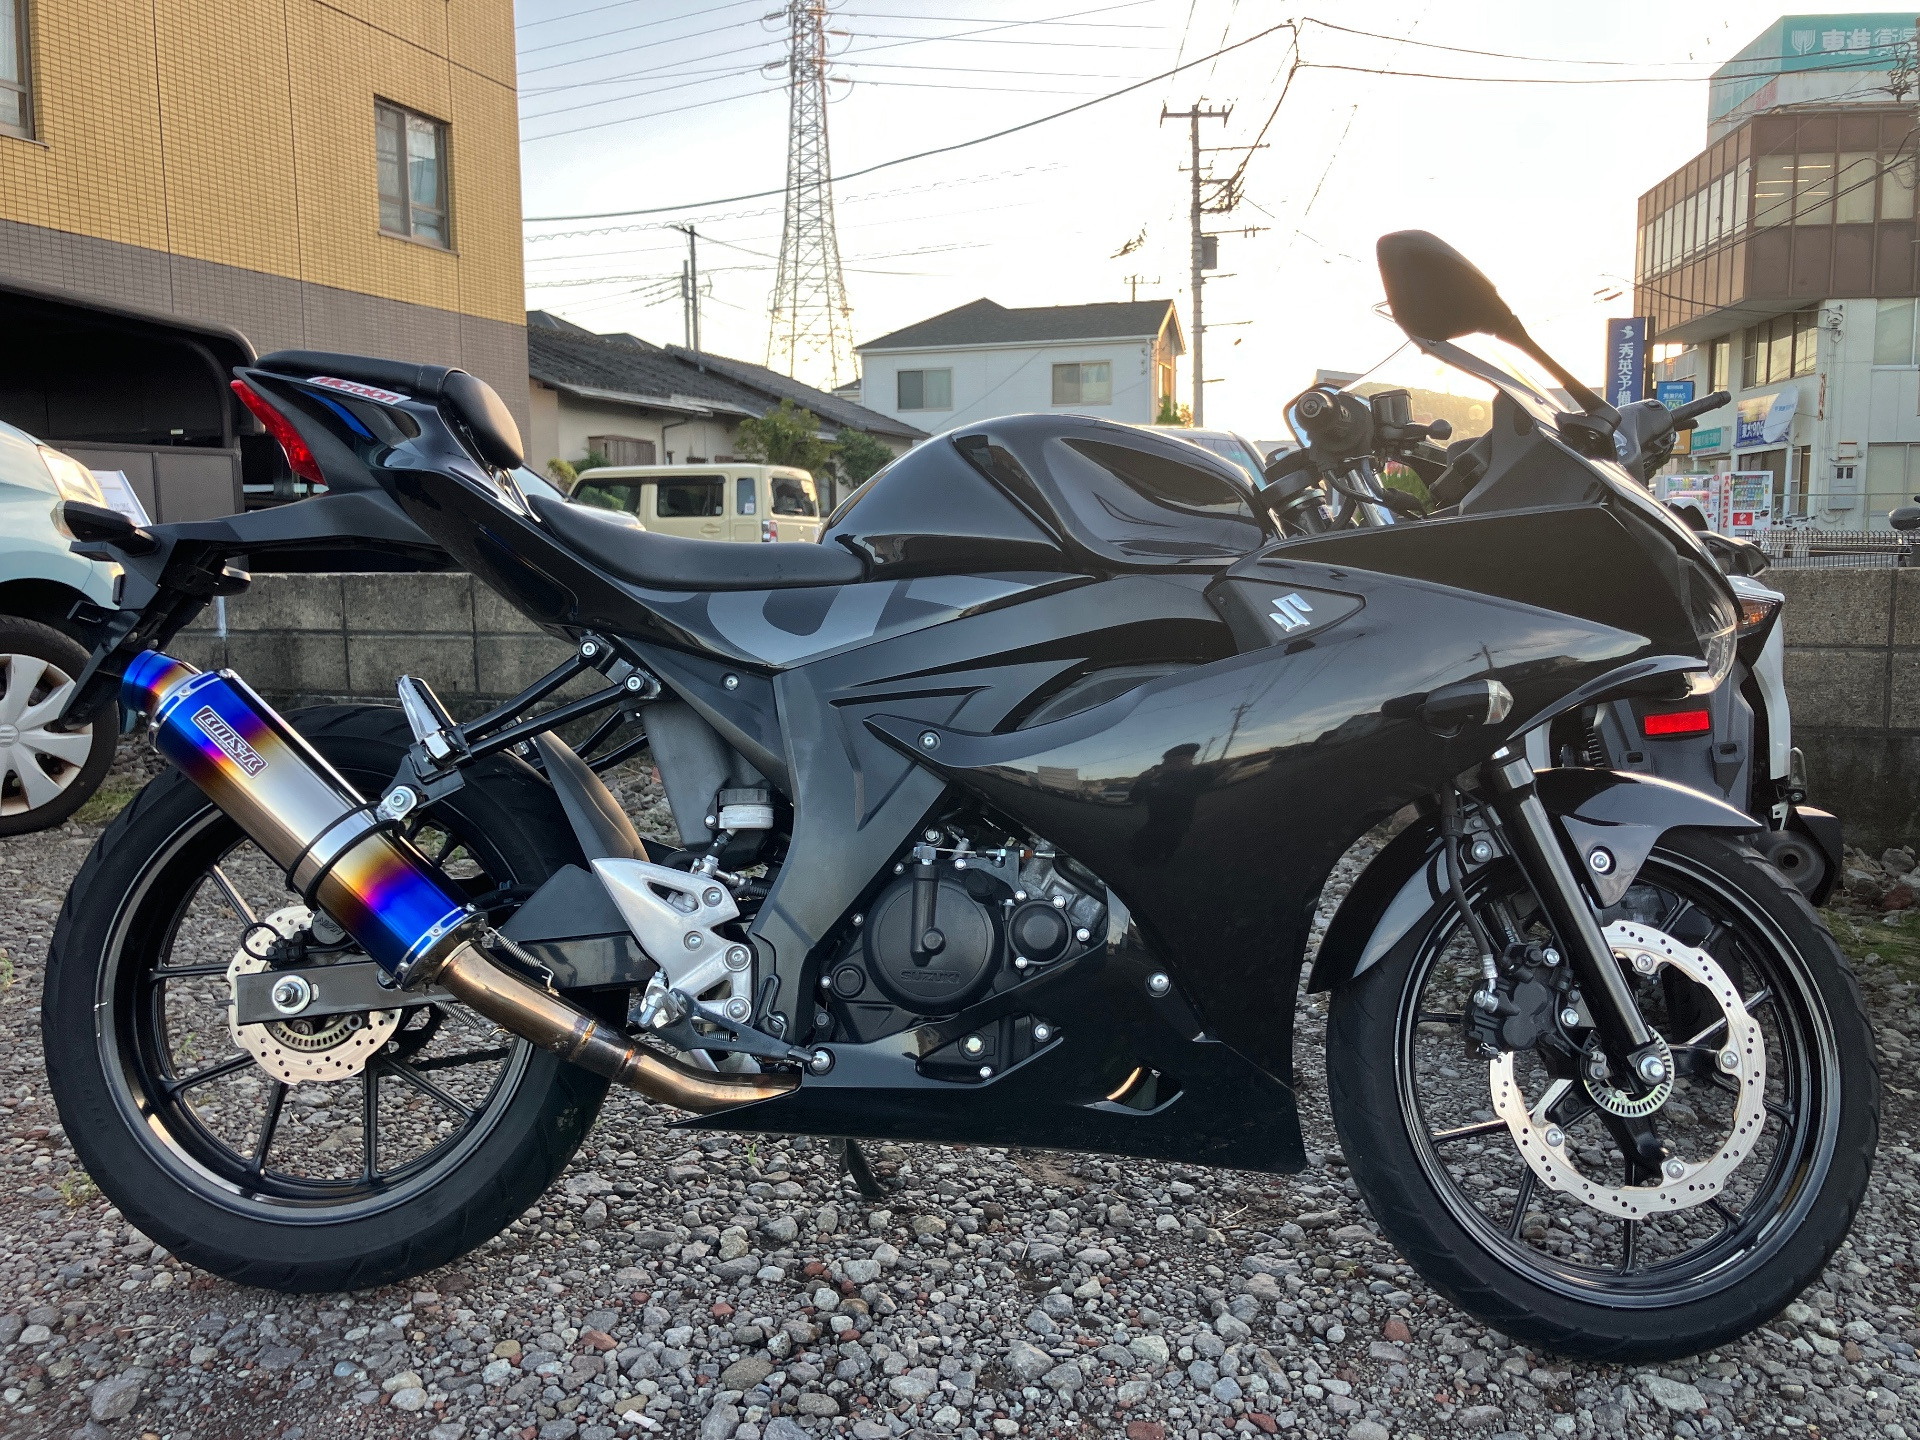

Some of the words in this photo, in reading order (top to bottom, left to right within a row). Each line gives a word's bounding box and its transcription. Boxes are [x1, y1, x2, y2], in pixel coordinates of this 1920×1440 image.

[313, 376, 400, 404] Microlon
[1617, 342, 1634, 406] 秀英予備
[201, 710, 264, 772] BMS-R
[899, 970, 961, 984] SUZUKI
